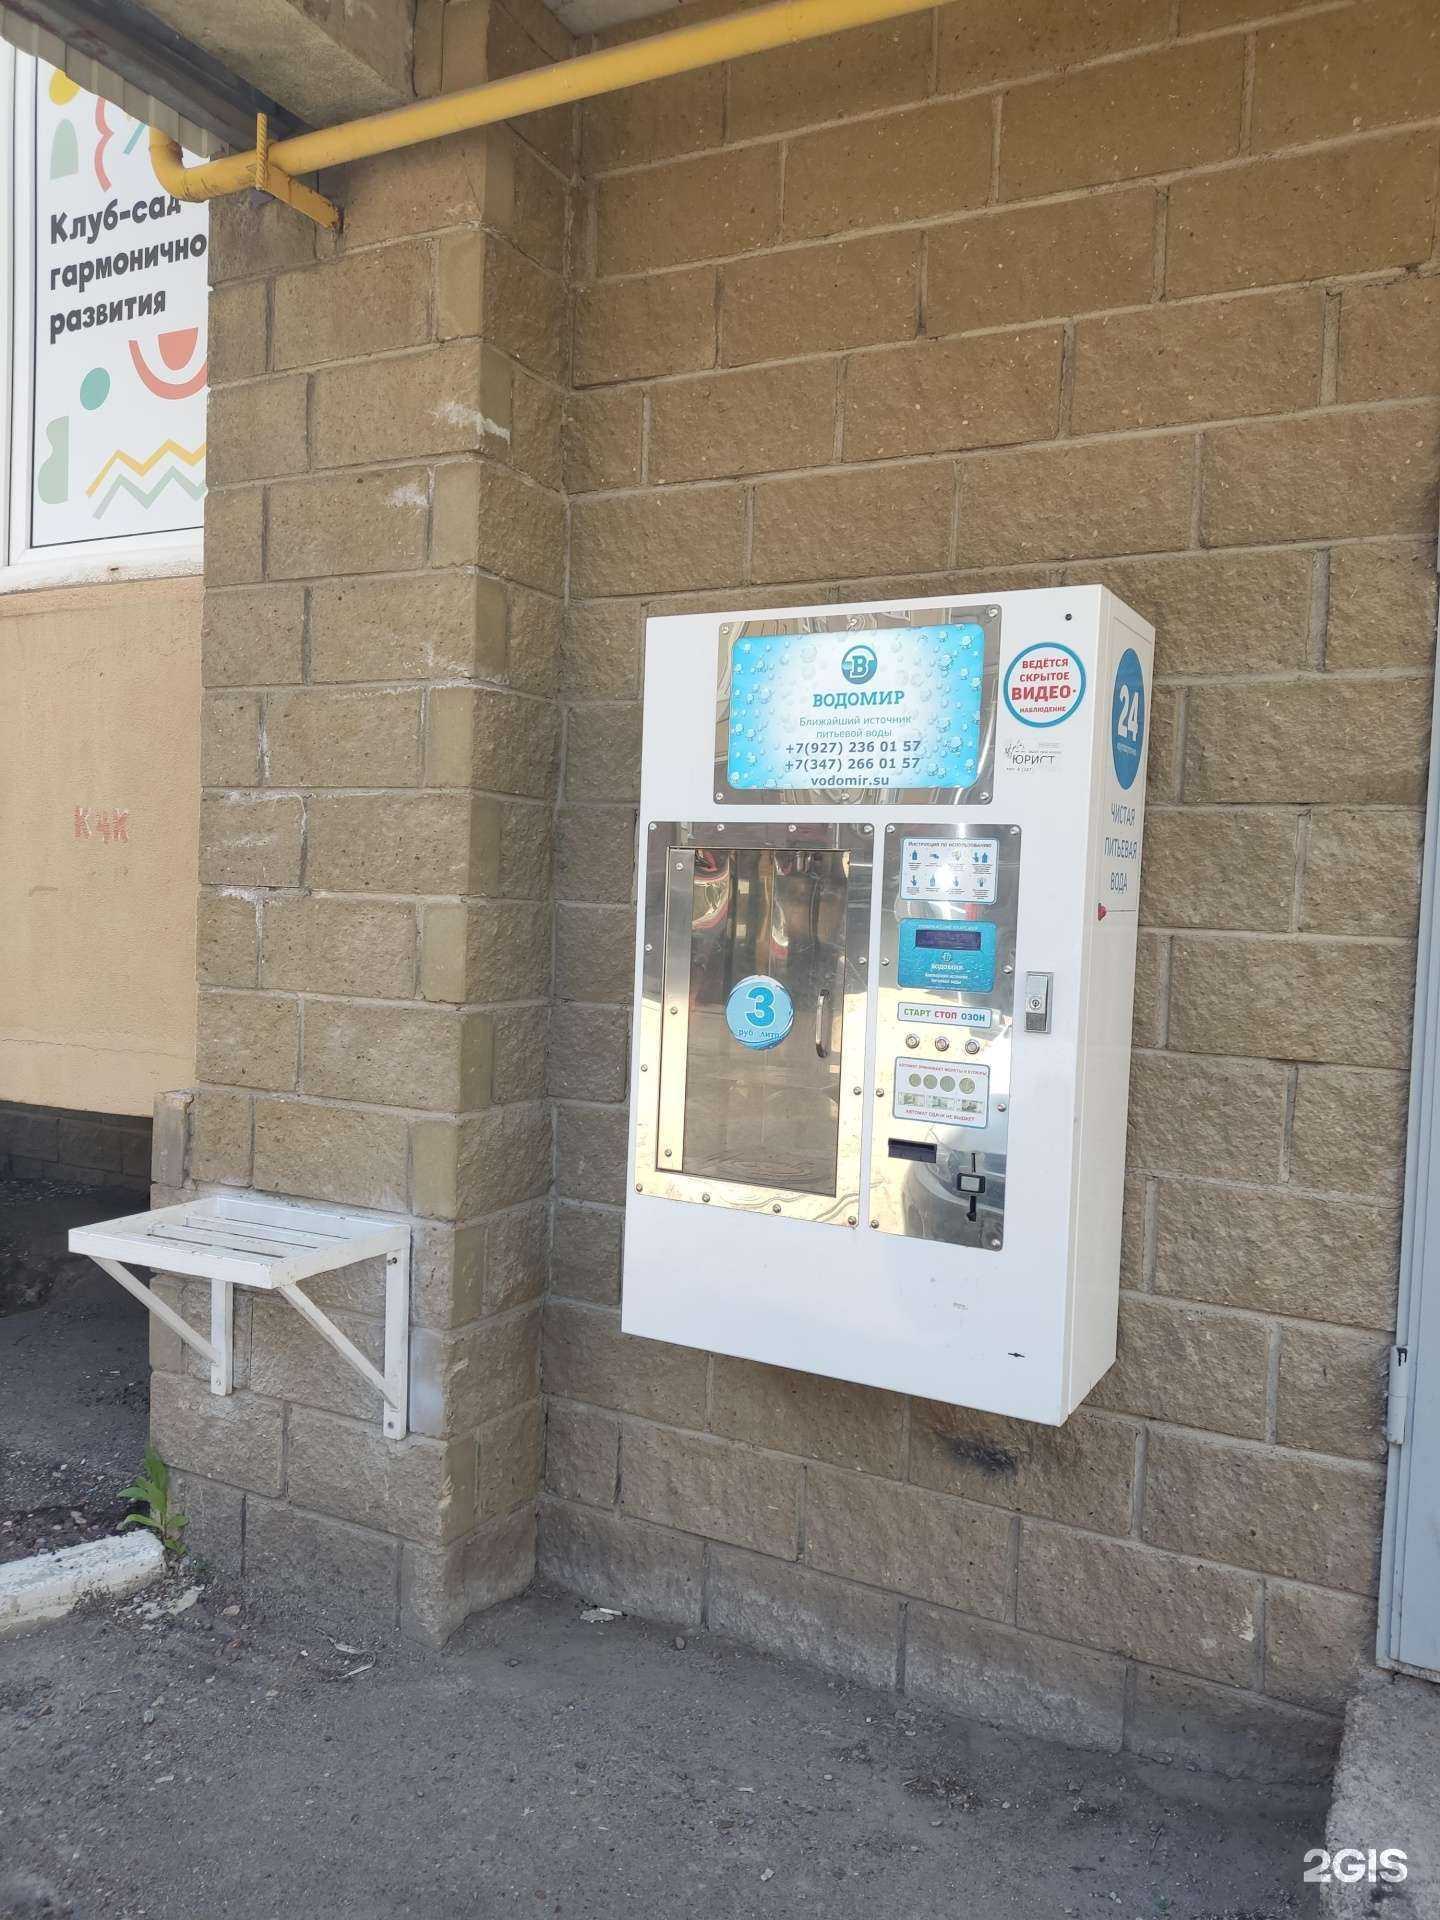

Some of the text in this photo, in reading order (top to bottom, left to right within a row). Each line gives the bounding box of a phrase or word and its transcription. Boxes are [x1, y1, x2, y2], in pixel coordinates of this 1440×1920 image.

[50, 290, 166, 344] развития
[1020, 672, 1070, 682] СКРЫТОЕ
[813, 690, 905, 709] ВОДОМИР
[1020, 706, 1067, 714] НАБЛЮДЕНИЕ
[1117, 684, 1139, 742] 24
[800, 715, 912, 727] Ближайший источник
[816, 728, 892, 738] питьевой воды
[786, 740, 921, 756] +7(927) 236 01 57
[785, 757, 920, 772] +7(347) 266 01 57
[811, 774, 889, 786] vodomir.su
[1111, 802, 1136, 826] ЧИСТАЯ
[1104, 837, 1138, 859] ПИТЬЕВАЯ
[1110, 872, 1128, 892] ВОДА
[745, 986, 775, 1028] 3
[904, 1008, 986, 1022] СТАРТ СТОП ОЗОН
